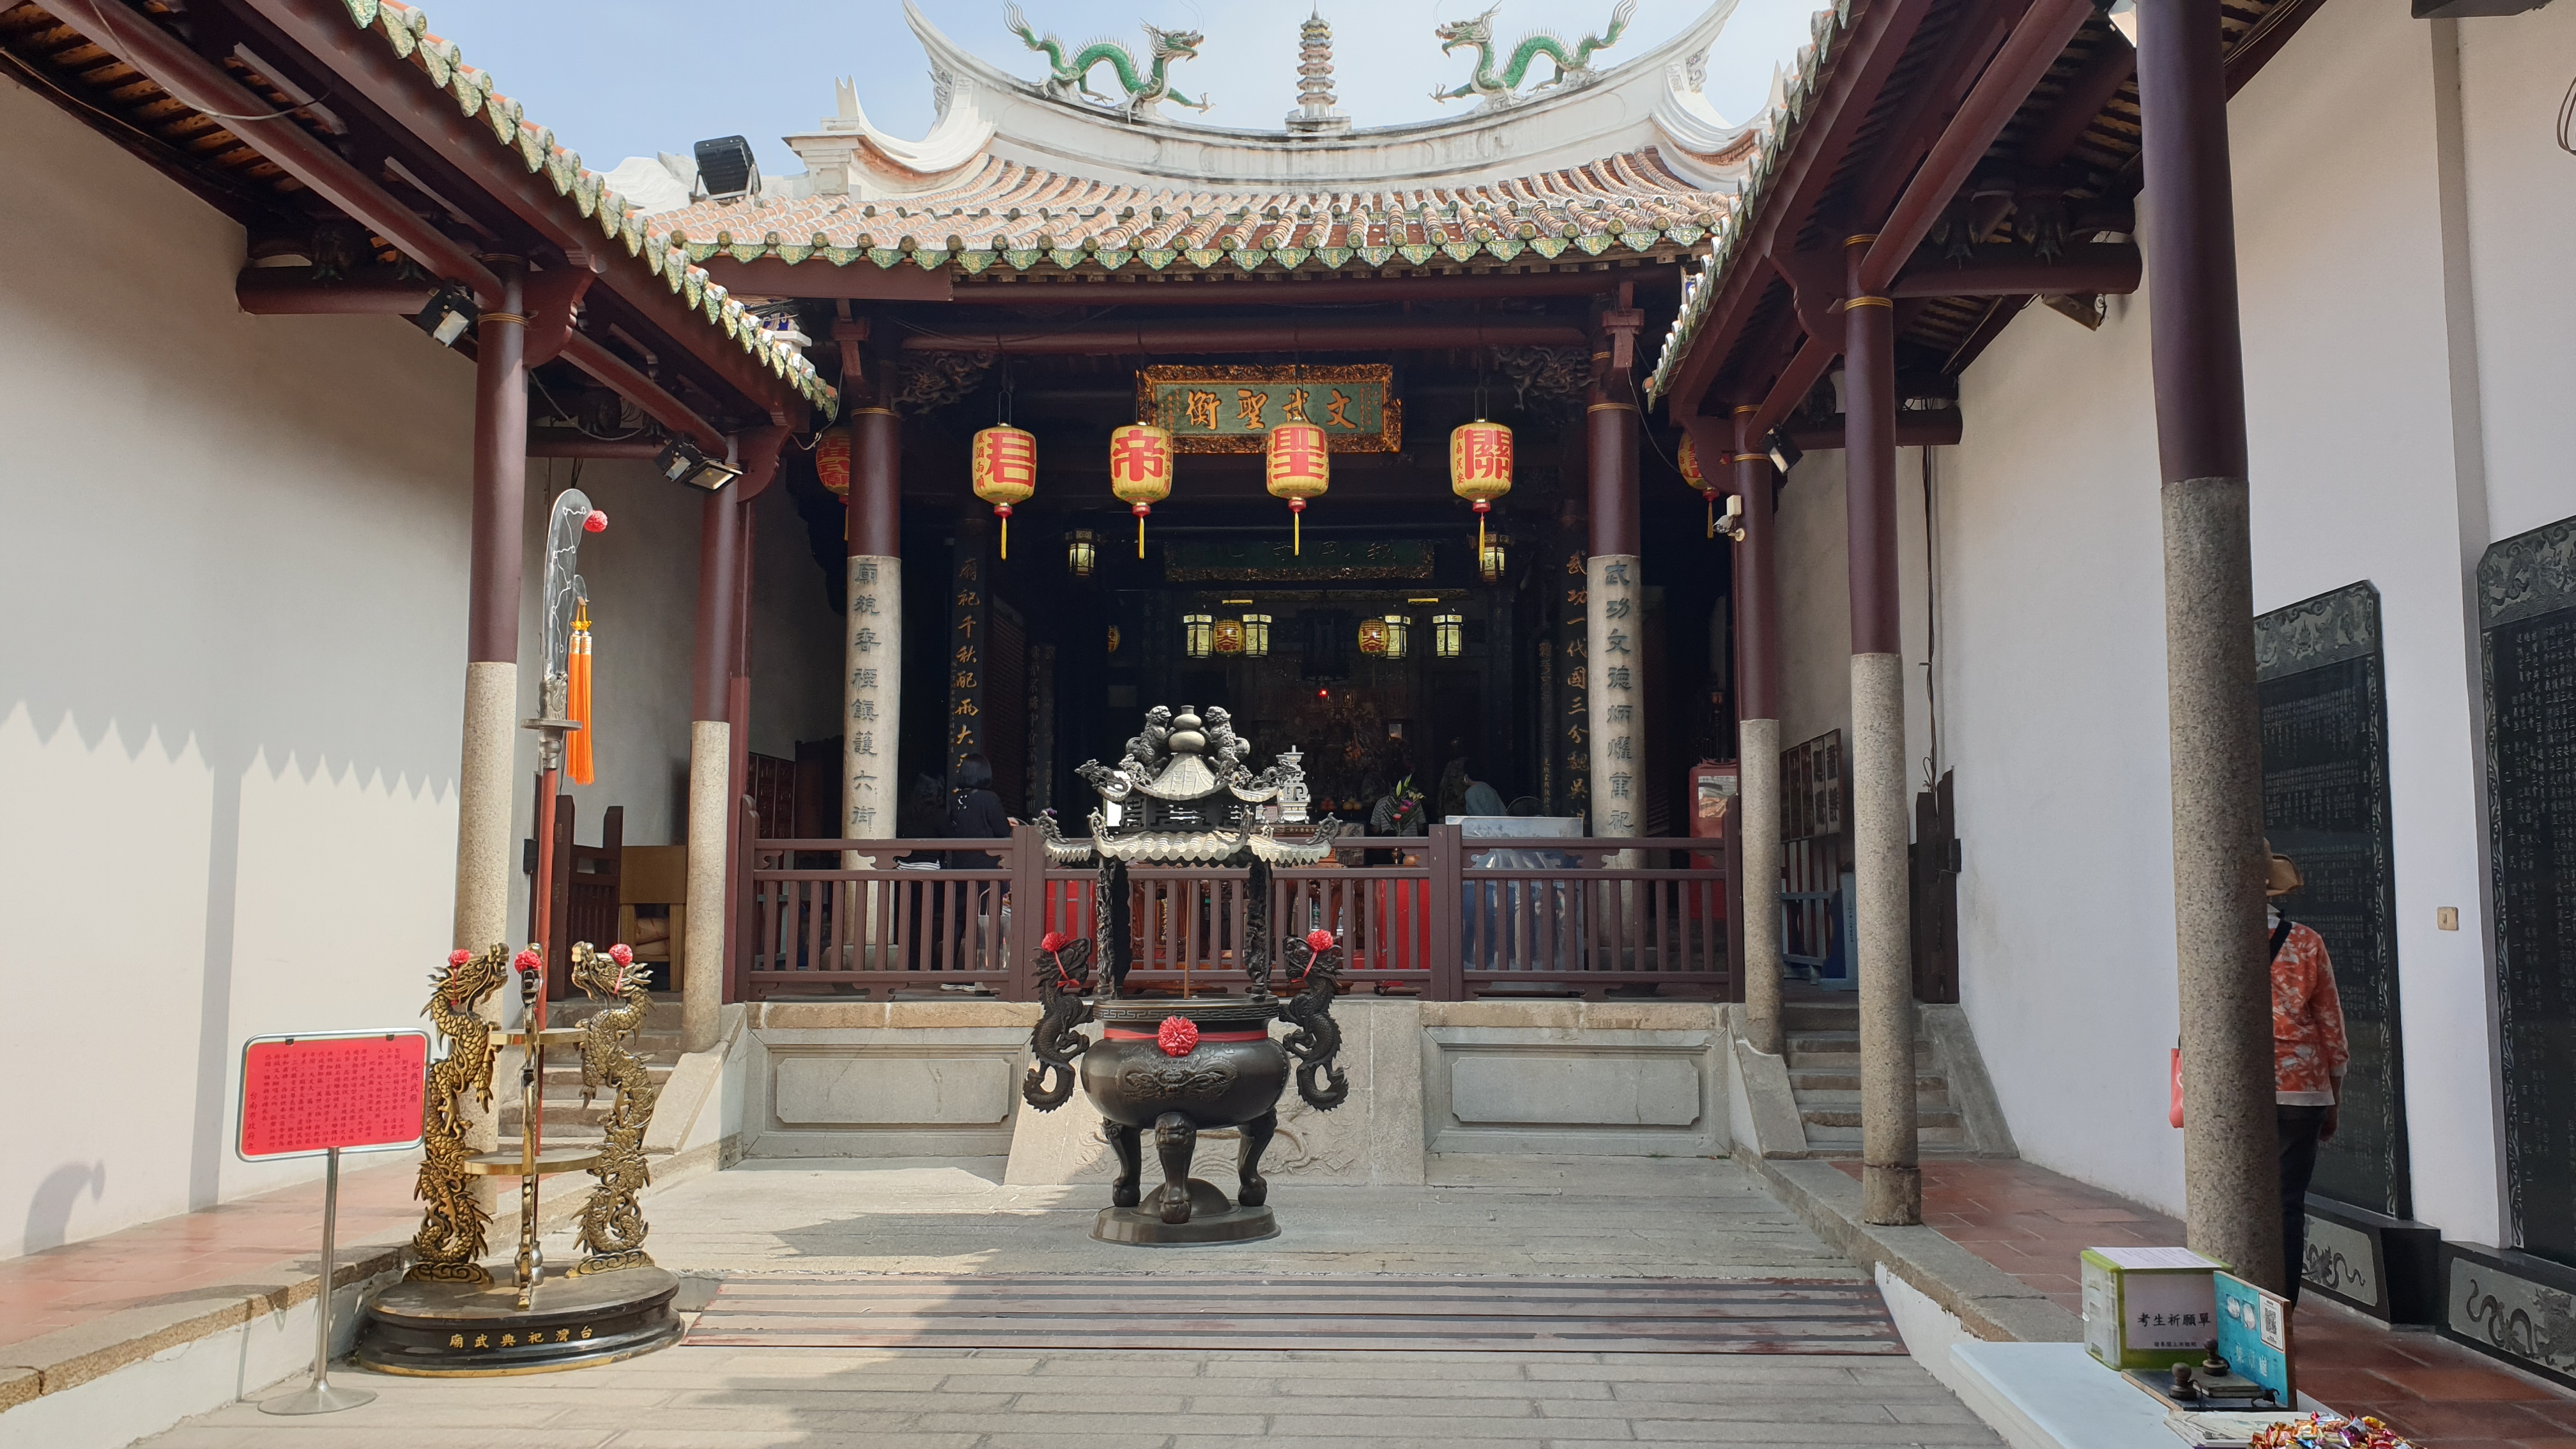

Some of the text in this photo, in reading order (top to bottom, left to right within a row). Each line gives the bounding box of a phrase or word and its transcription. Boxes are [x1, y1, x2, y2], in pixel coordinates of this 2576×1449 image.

[985, 432, 1036, 487] 君
[1112, 429, 1165, 482] 帝
[1273, 427, 1325, 480] 聖
[1464, 429, 1512, 483] 關
[409, 1061, 420, 1104] 祀典武廟
[449, 1326, 594, 1349] 台灣祀典武廟
[2138, 1312, 2211, 1327] 考生祈願單
